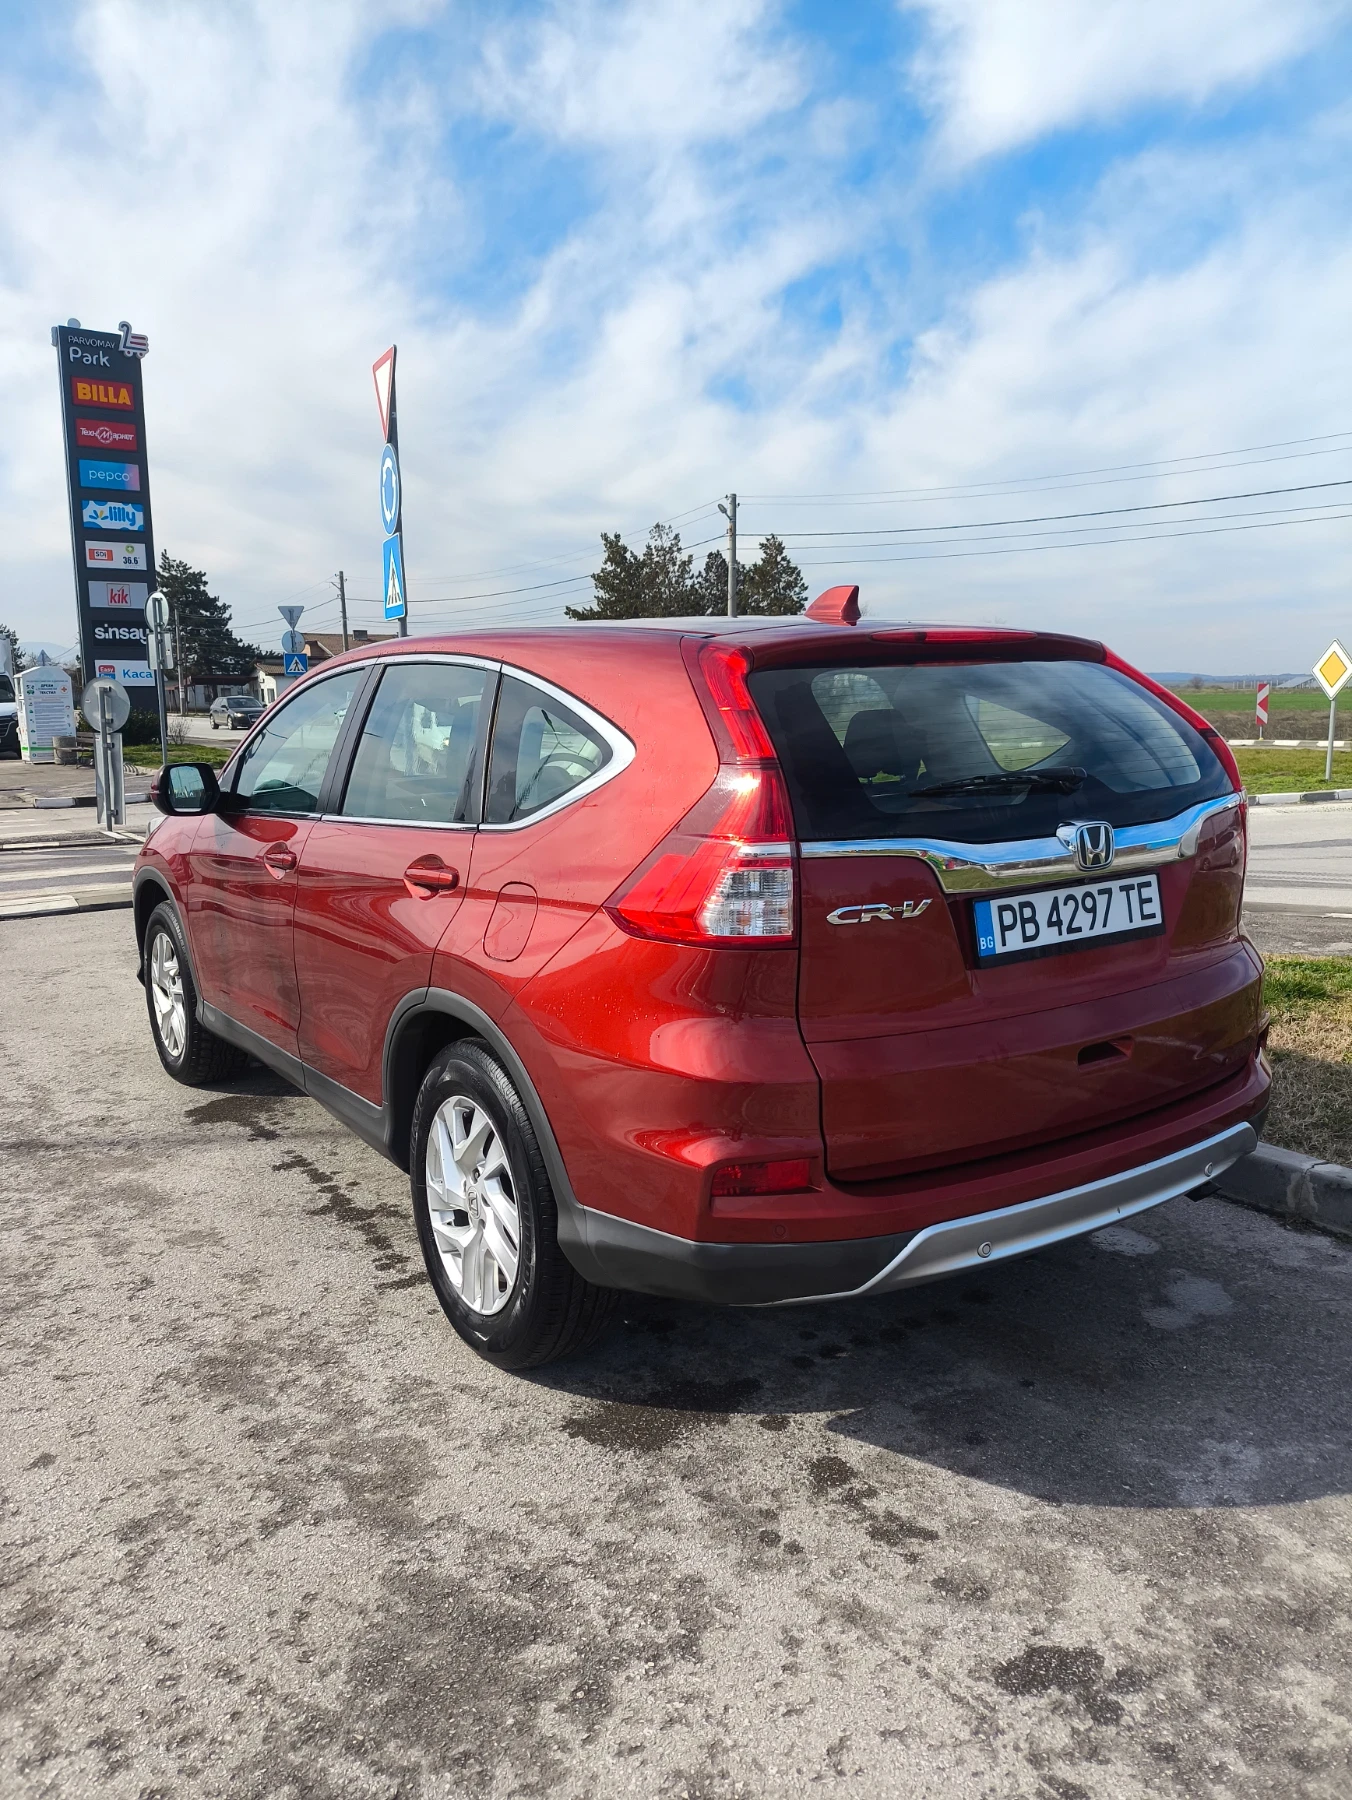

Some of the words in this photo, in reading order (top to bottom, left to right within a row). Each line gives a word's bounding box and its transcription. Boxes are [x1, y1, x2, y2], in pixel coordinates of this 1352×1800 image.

[68, 335, 116, 349] PARVOMAY
[69, 346, 111, 368] Park
[76, 382, 132, 406] BILLA
[88, 469, 131, 483] pepco
[108, 505, 136, 527] lilly
[122, 556, 139, 565] 36.6
[109, 586, 129, 605] kik
[94, 623, 149, 645] sinsay
[826, 898, 934, 926] CR-V
[997, 900, 1041, 947] PB
[1046, 887, 1113, 937] 4297
[1118, 880, 1157, 924] TE
[979, 935, 994, 950] BG
